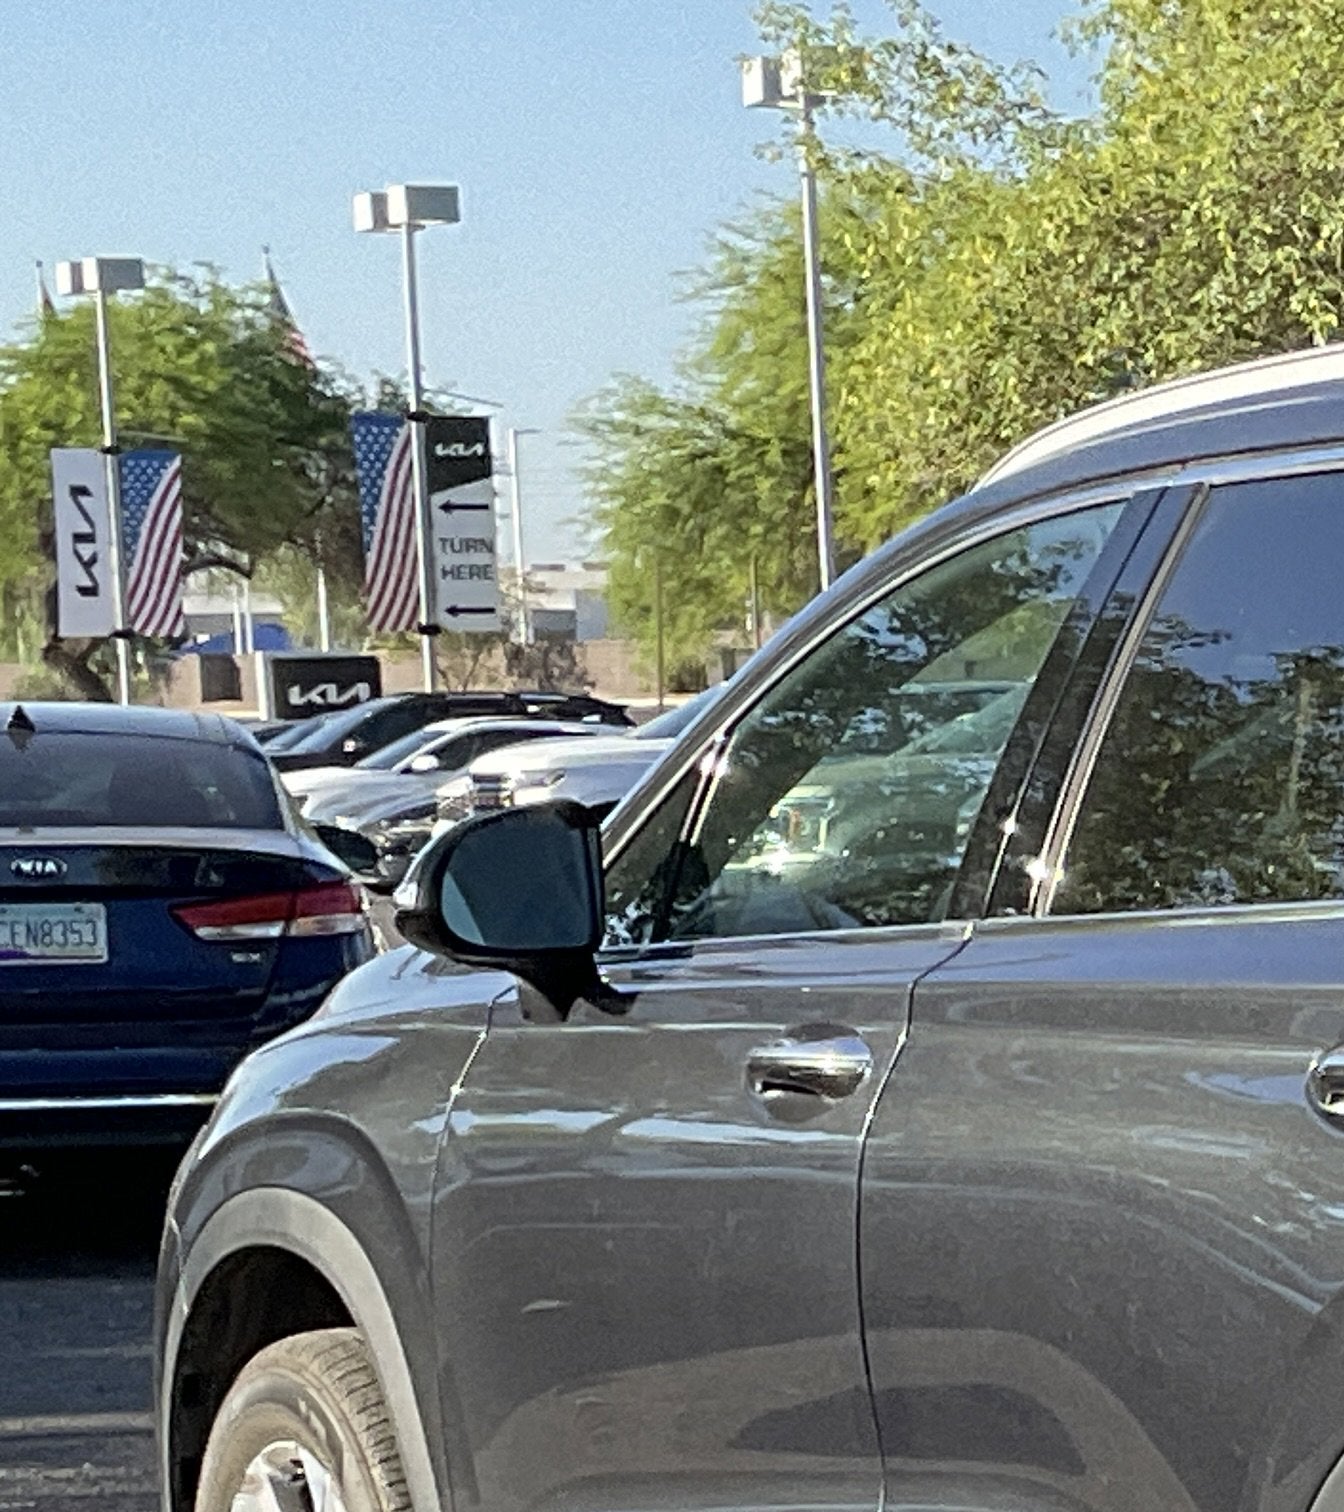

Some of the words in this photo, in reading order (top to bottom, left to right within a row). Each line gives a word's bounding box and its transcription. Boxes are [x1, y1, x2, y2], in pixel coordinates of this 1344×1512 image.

[69, 484, 99, 598] KIA
[438, 537, 495, 555] TURN
[441, 563, 495, 581] HERE
[287, 681, 371, 706] KIA
